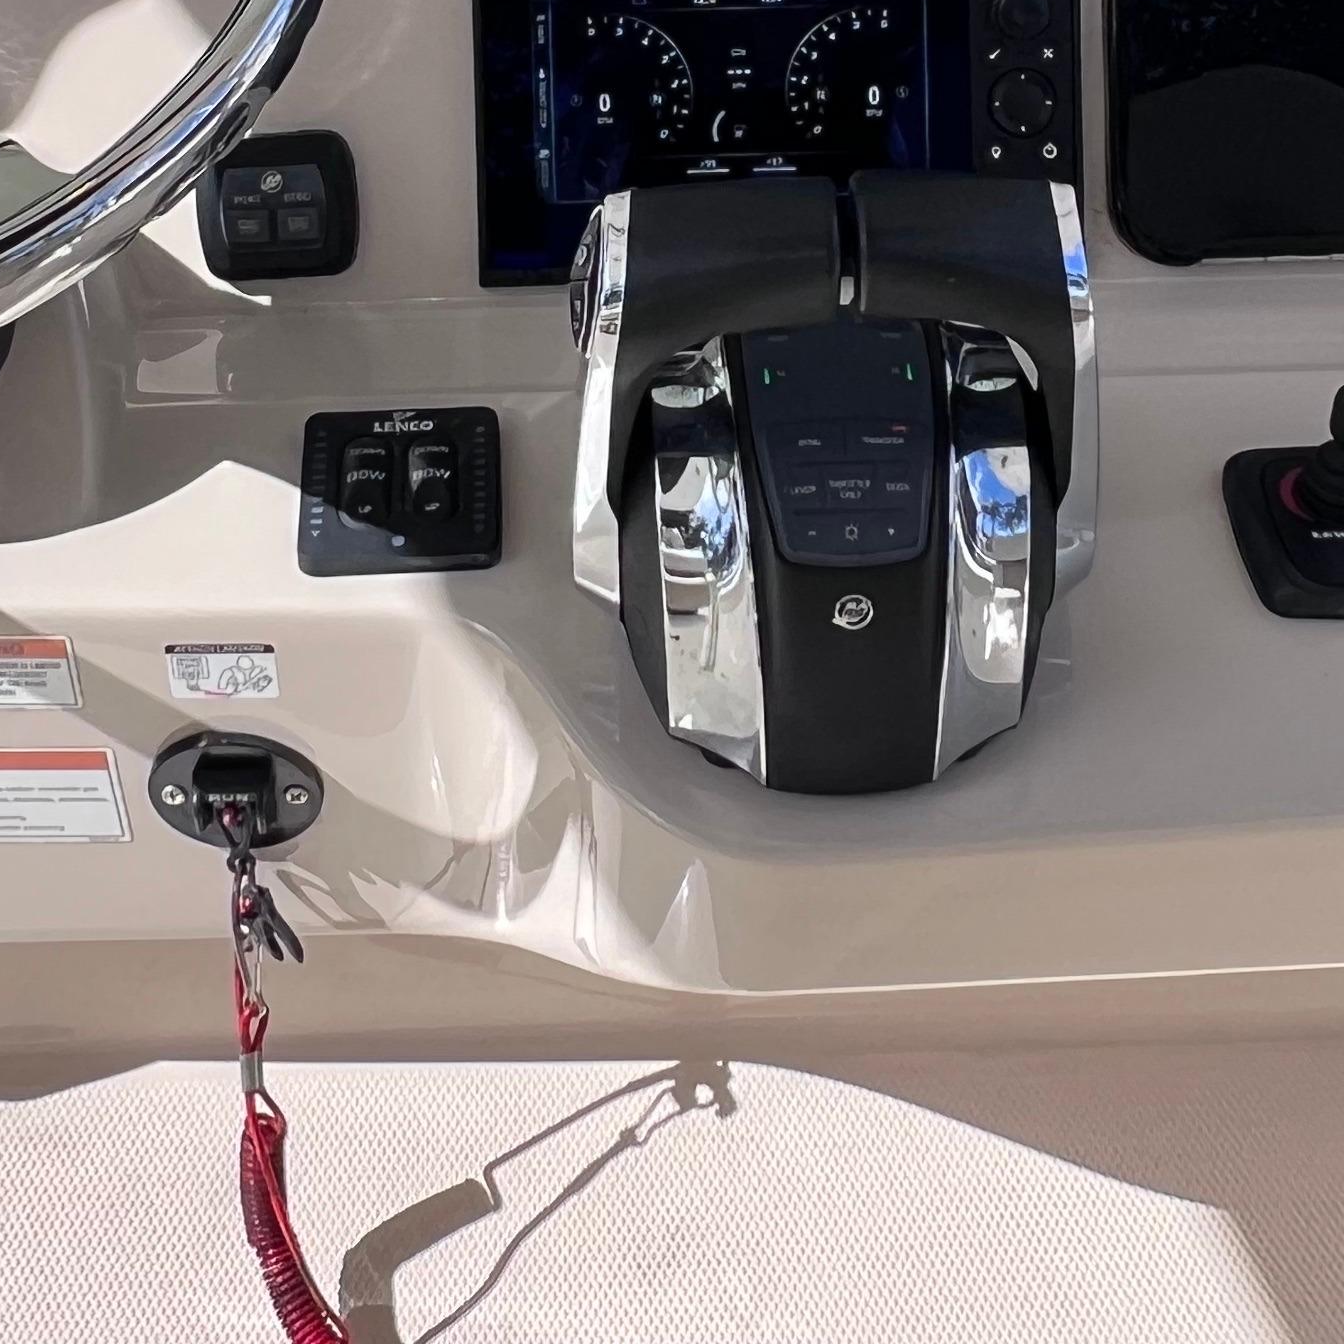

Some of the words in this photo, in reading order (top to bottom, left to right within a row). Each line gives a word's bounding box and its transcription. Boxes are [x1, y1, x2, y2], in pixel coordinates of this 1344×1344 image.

[599, 93, 611, 112] 0
[868, 85, 880, 105] 0
[373, 420, 434, 433] LENCO
